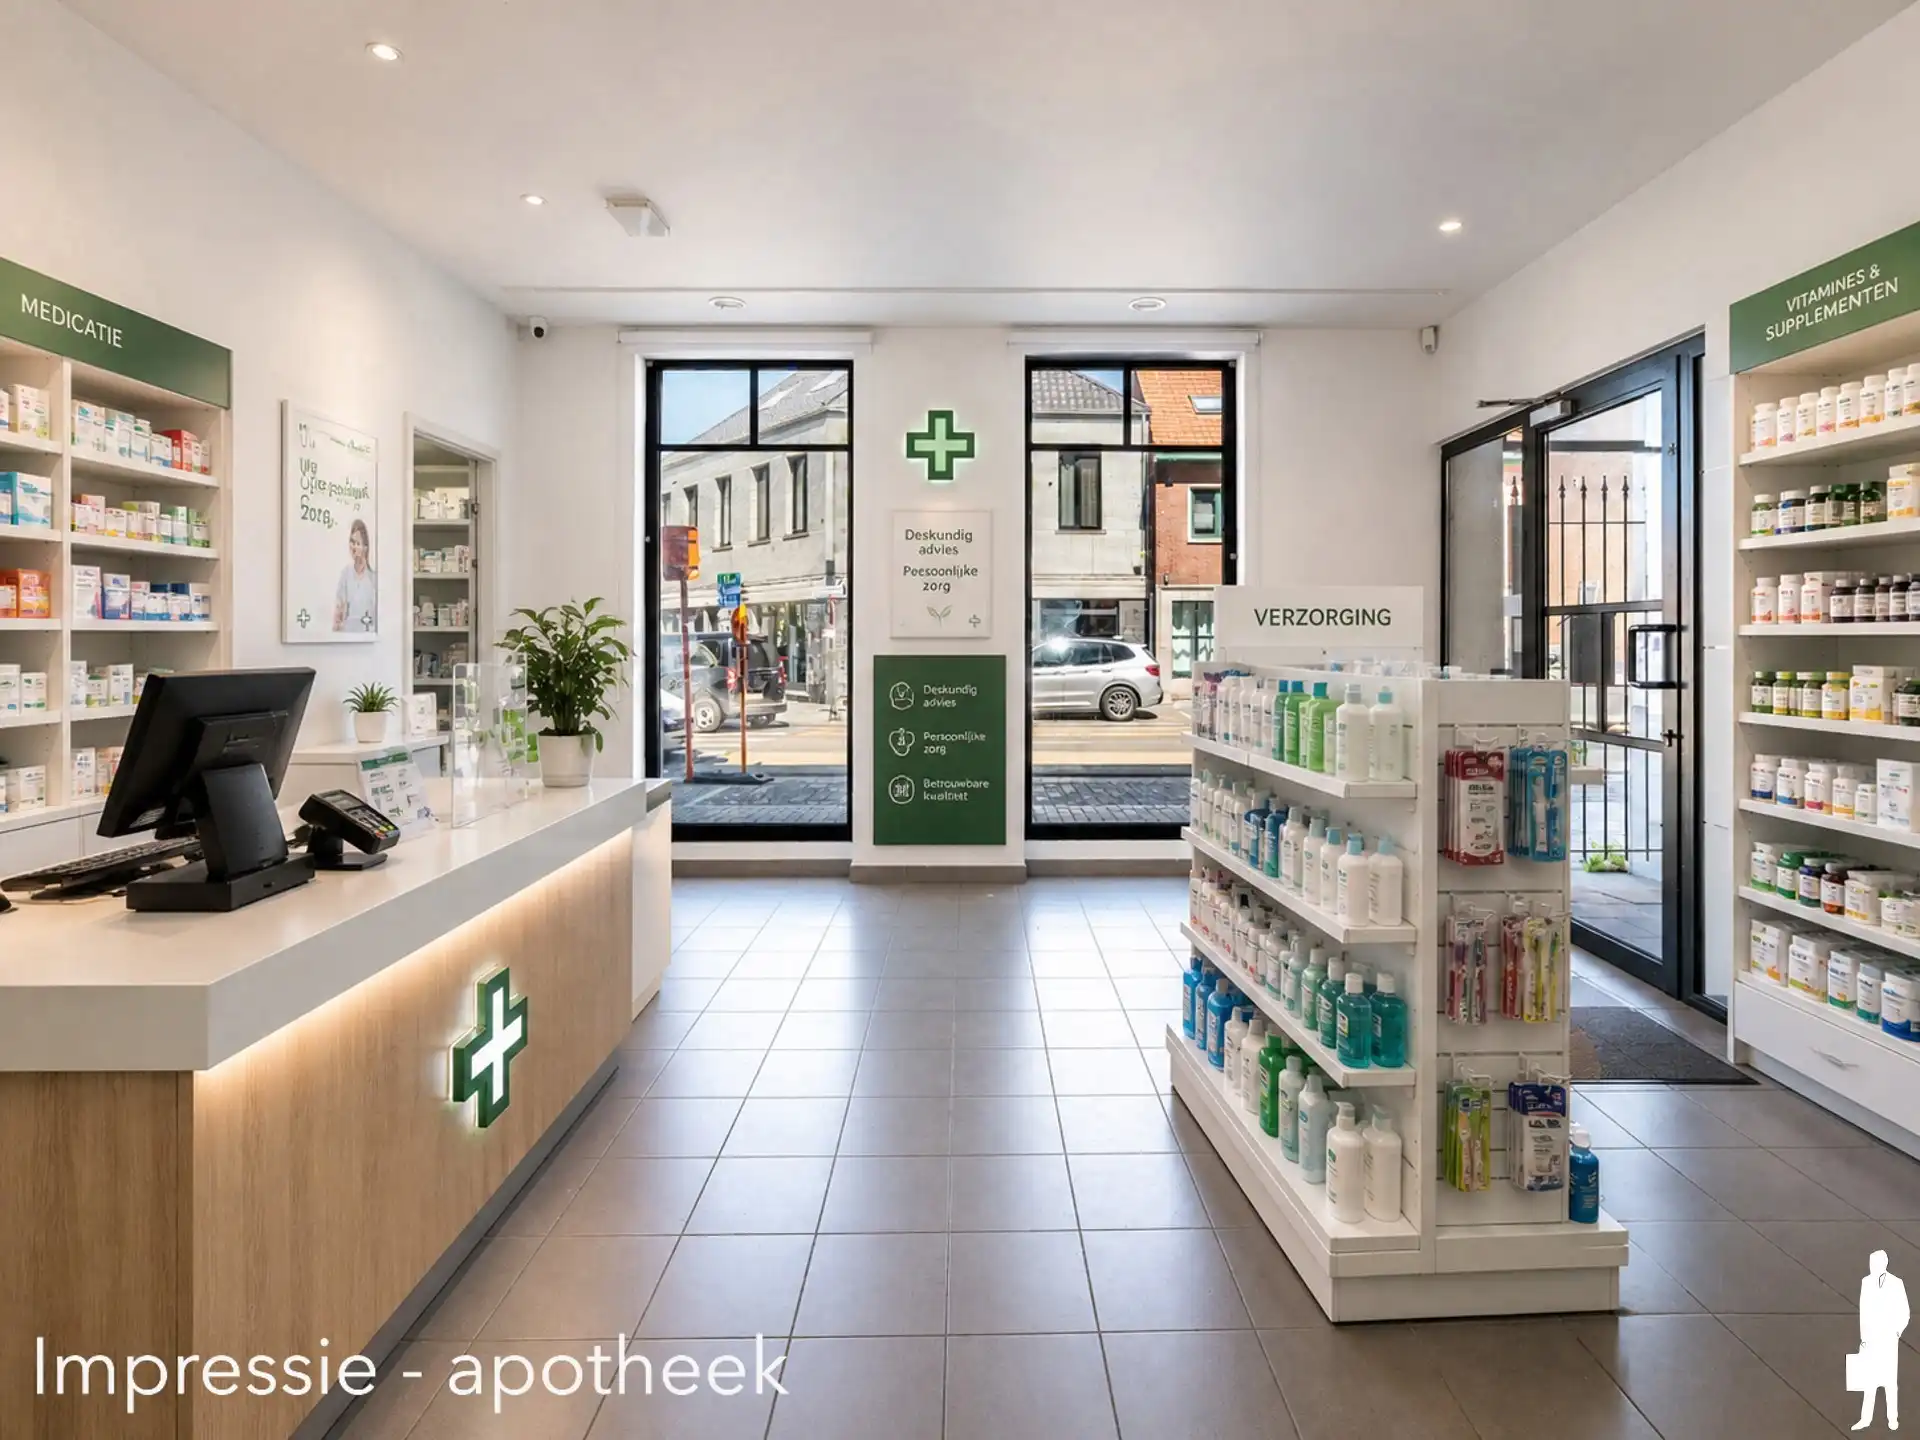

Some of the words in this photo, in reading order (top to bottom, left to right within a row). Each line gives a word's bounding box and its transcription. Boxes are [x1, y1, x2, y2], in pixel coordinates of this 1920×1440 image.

[1786, 268, 1865, 313] VITAMINES
[1869, 263, 1881, 280] &
[1765, 276, 1899, 342] SUPPLEMENTEN
[21, 293, 124, 349] MEDICATIE
[904, 528, 973, 543] Deskundig
[918, 543, 959, 556] advies
[922, 581, 951, 594] zorg
[1254, 608, 1392, 627] VERZORGING
[923, 697, 957, 708] advies
